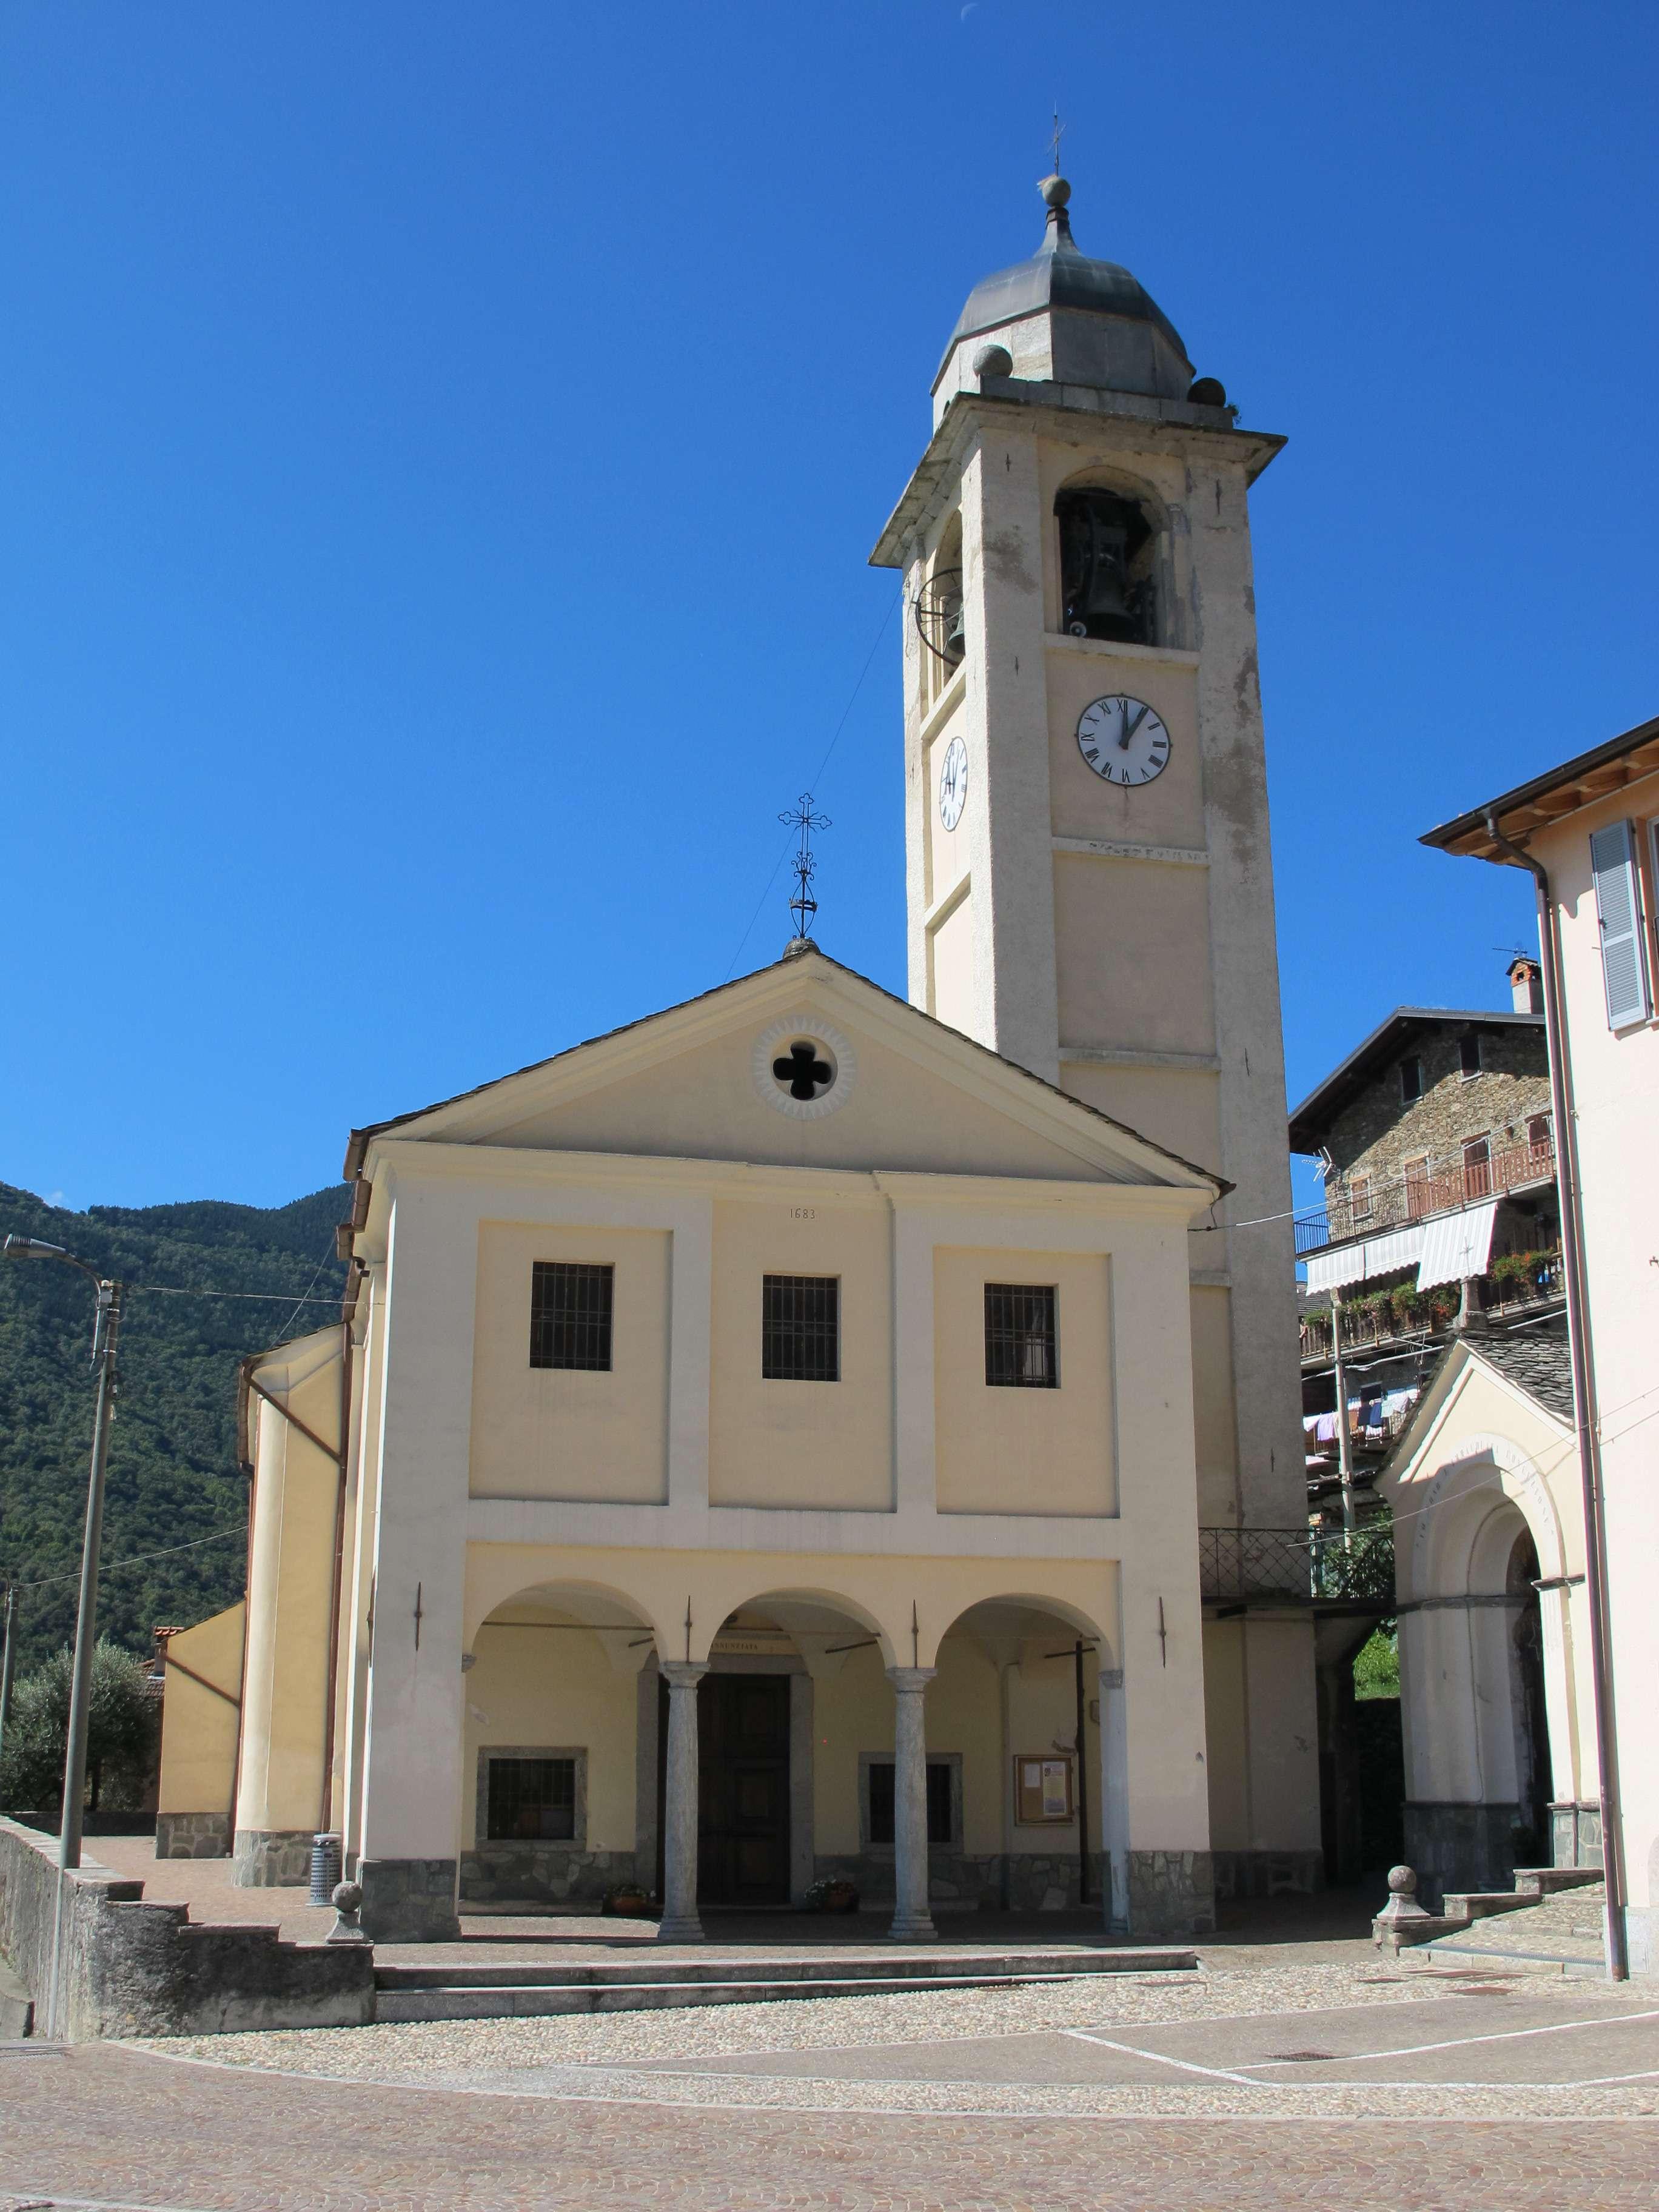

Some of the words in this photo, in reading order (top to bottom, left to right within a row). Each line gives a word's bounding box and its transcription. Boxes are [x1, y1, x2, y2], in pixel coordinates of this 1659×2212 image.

[1098, 701, 1111, 716] XI
[1085, 714, 1099, 725] X
[1081, 732, 1094, 742] IX
[1122, 768, 1130, 783] VI
[1141, 768, 1150, 780] V
[790, 1208, 815, 1219] 1683
